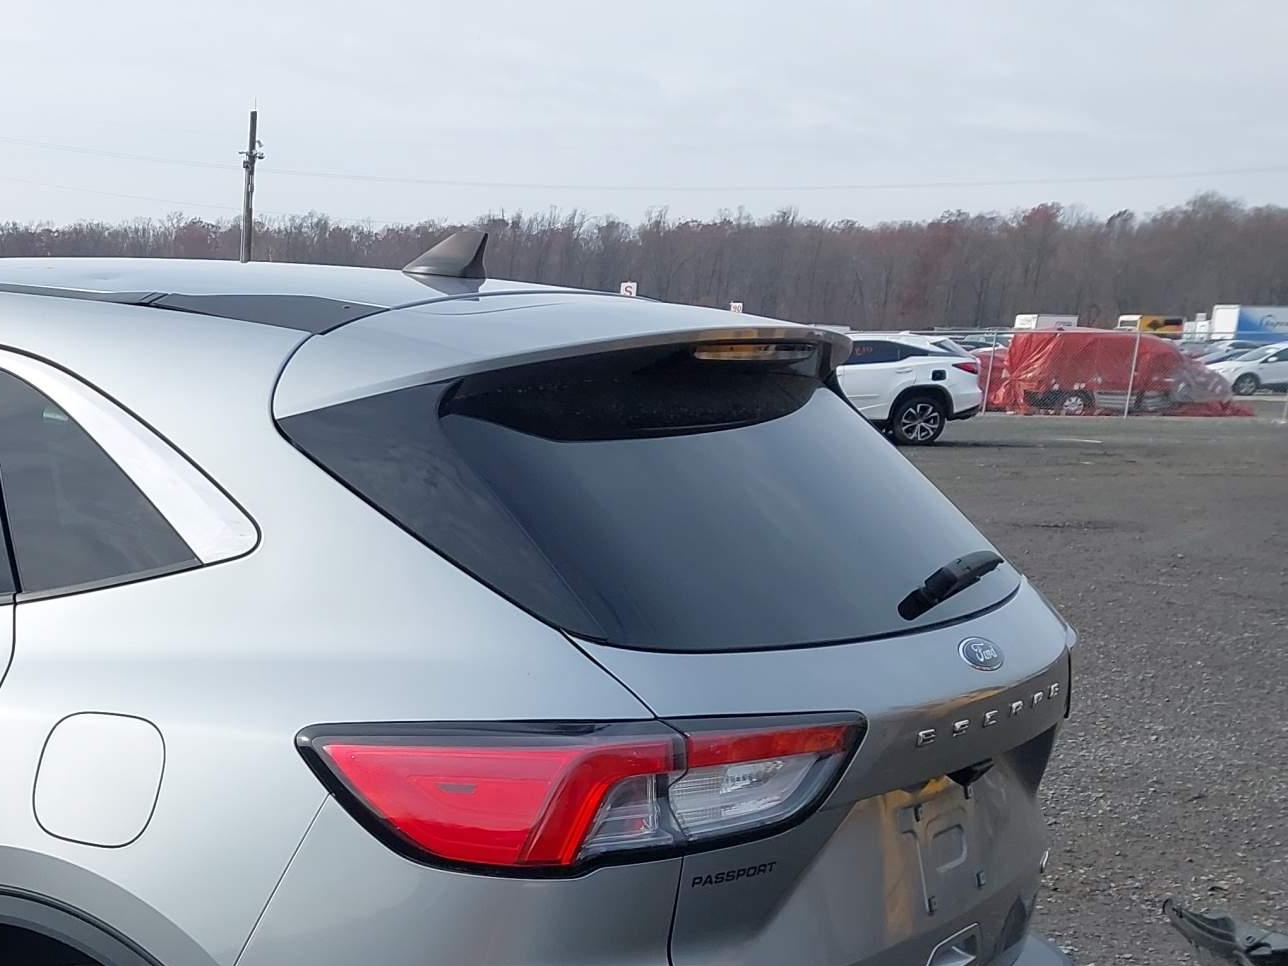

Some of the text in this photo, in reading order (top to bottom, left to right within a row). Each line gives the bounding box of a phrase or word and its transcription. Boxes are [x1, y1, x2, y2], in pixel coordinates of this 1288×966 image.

[624, 285, 633, 296] S
[971, 642, 998, 662] Ford
[691, 861, 777, 888] PASSPORT
